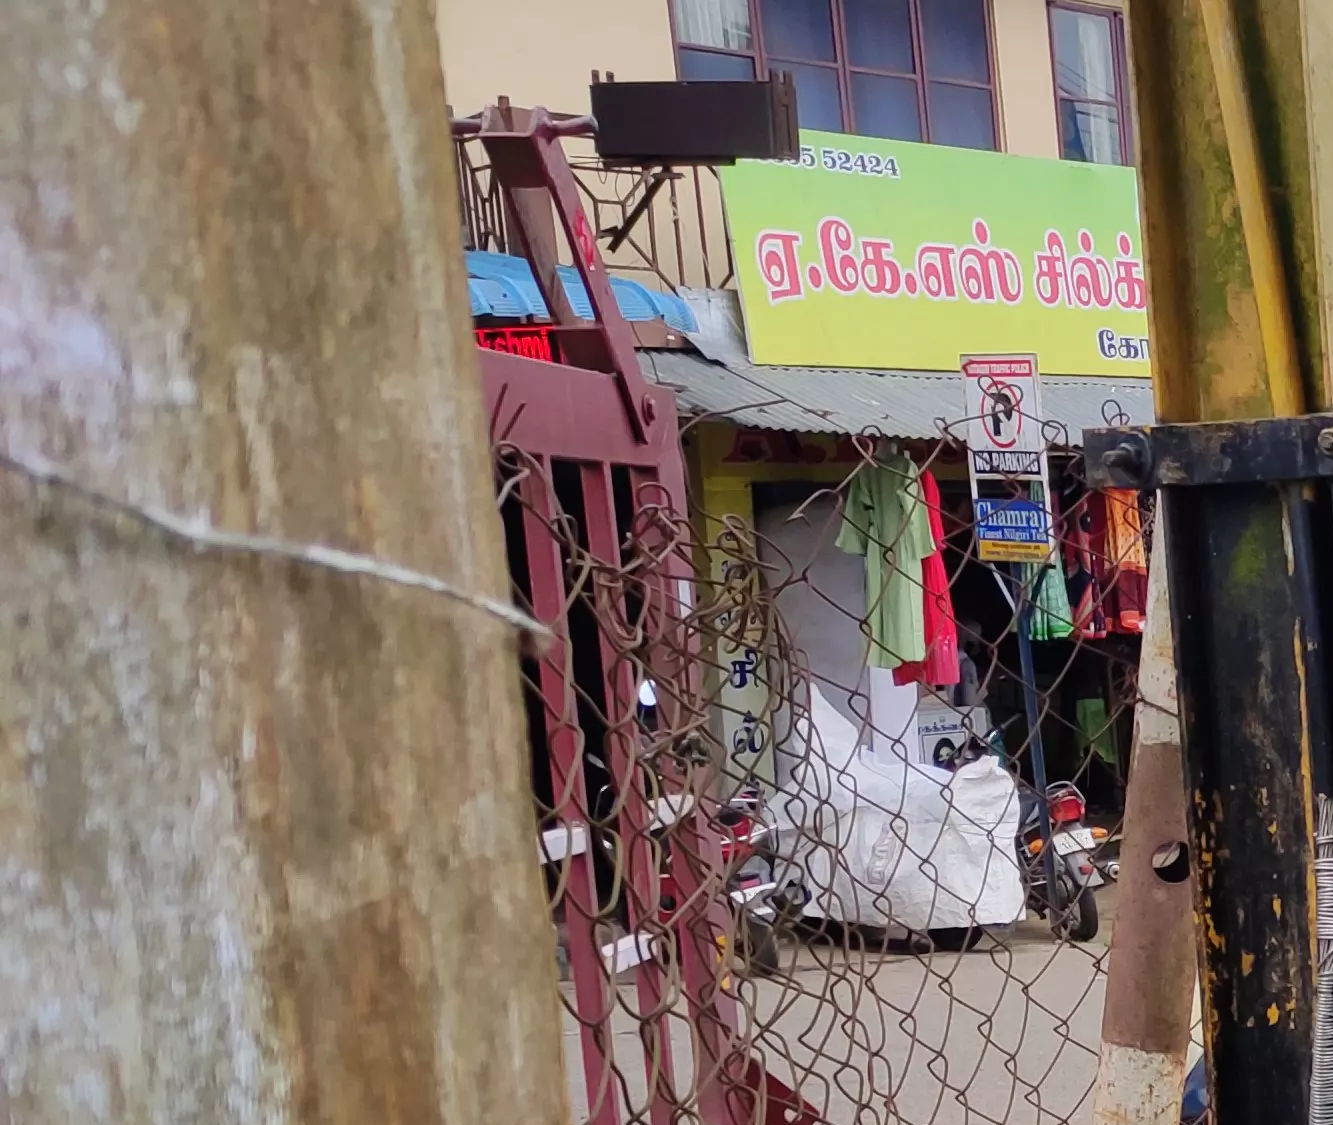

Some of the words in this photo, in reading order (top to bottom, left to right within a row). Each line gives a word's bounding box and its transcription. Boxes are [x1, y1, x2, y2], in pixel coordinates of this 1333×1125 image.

[823, 149, 898, 177] 52424
[975, 452, 991, 471] NO
[992, 452, 1038, 473] PARKING
[976, 501, 1046, 532] Chamraj
